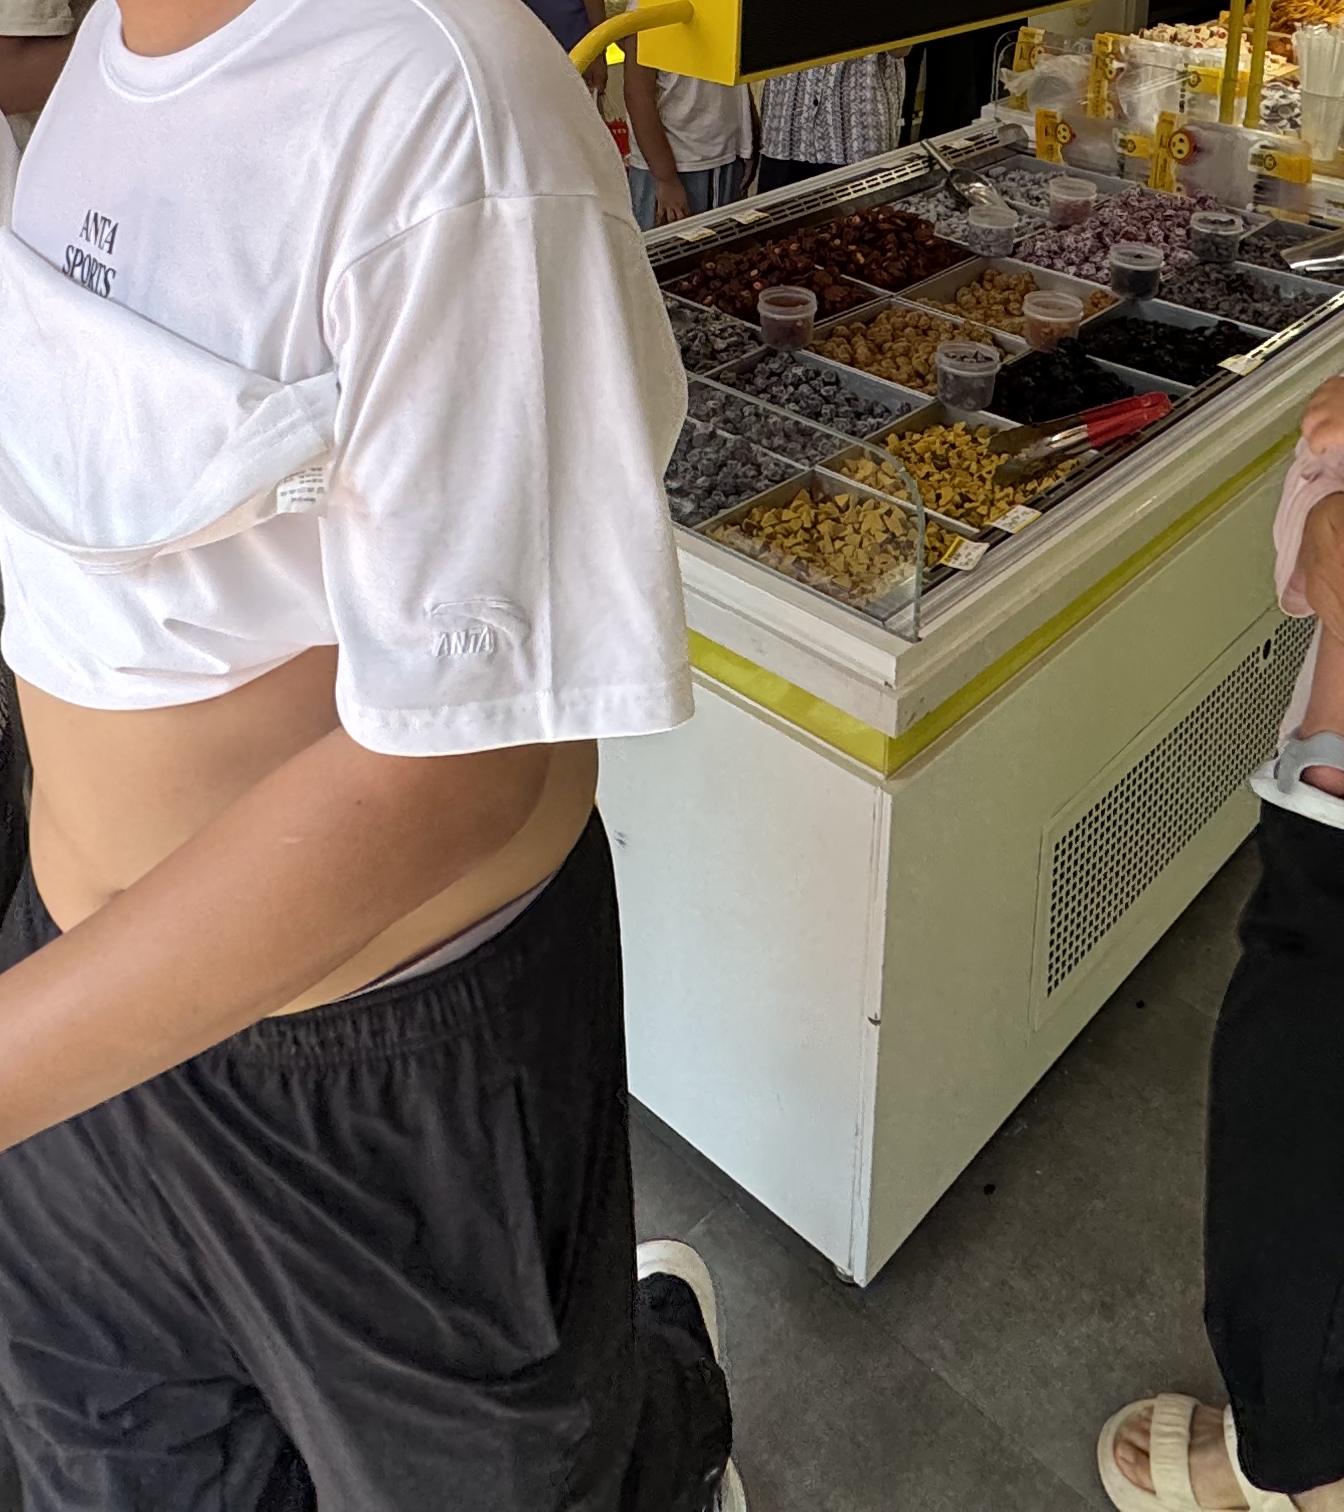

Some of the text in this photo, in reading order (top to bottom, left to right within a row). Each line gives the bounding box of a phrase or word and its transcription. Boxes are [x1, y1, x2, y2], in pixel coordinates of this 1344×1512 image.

[79, 208, 119, 255] ANTA
[64, 244, 117, 299] SPORTS
[432, 626, 495, 658] ANTA
